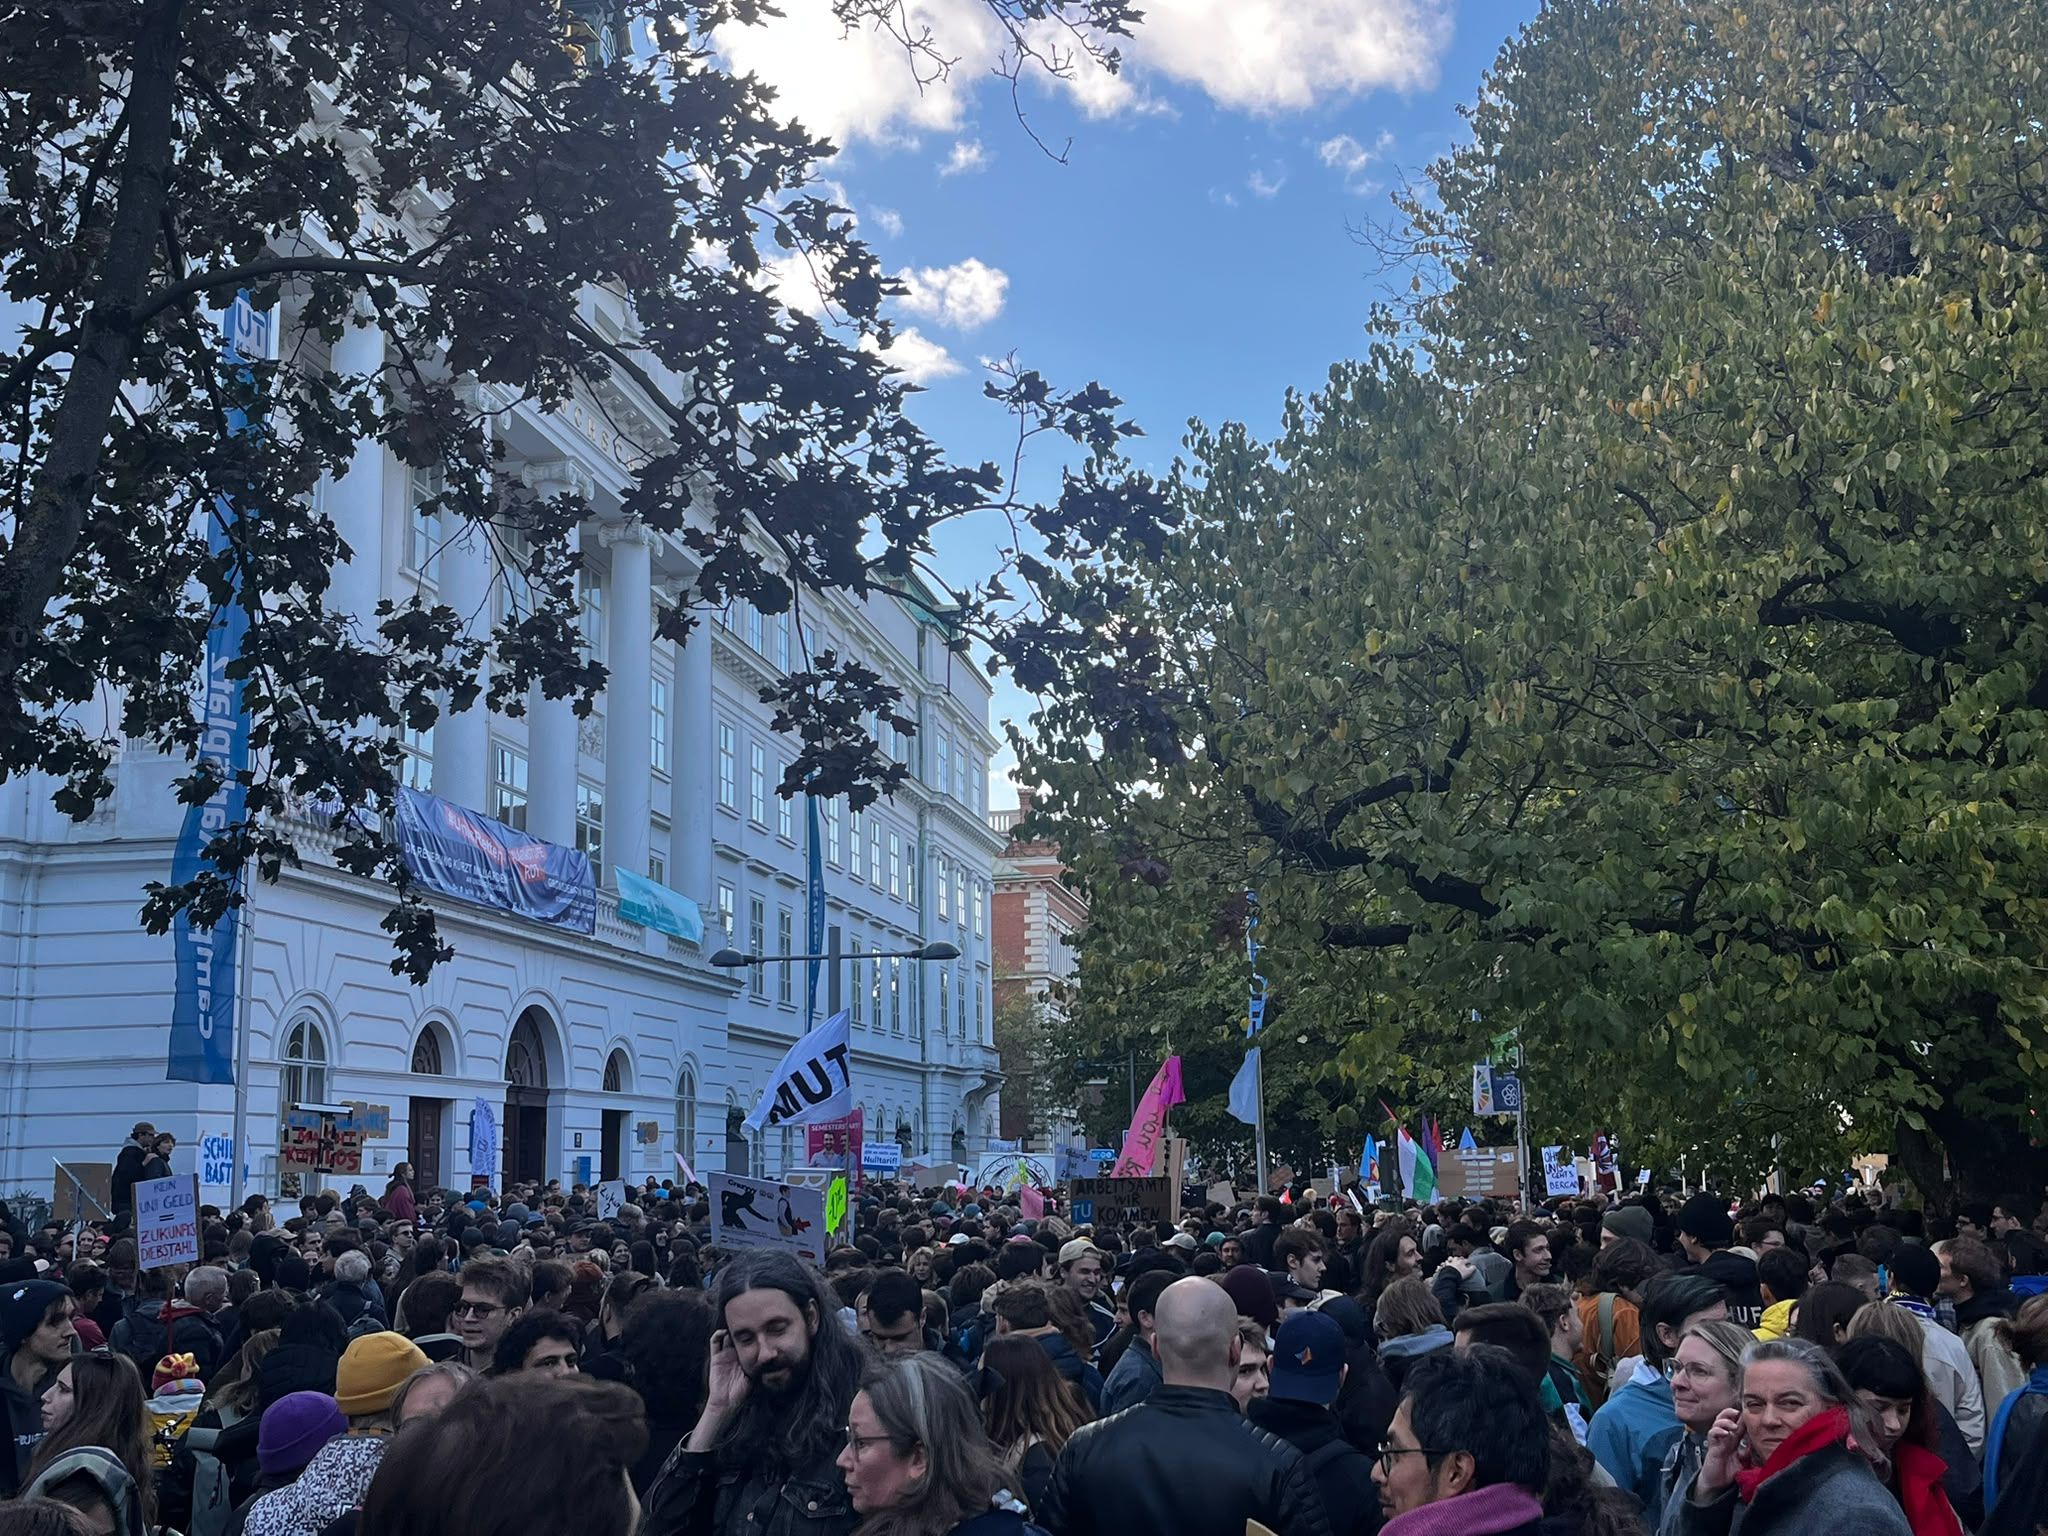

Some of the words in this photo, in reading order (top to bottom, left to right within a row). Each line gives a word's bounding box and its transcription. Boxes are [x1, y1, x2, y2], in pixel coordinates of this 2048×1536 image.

[769, 1042, 850, 1125] MUT
[204, 1137, 233, 1160] SCHIL
[153, 1180, 177, 1193] KEIN
[139, 1198, 159, 1214] UNI
[162, 1193, 193, 1209] GELD
[140, 1222, 196, 1244] ZUKUNFTS
[141, 1240, 197, 1261] DIEBSTAHL
